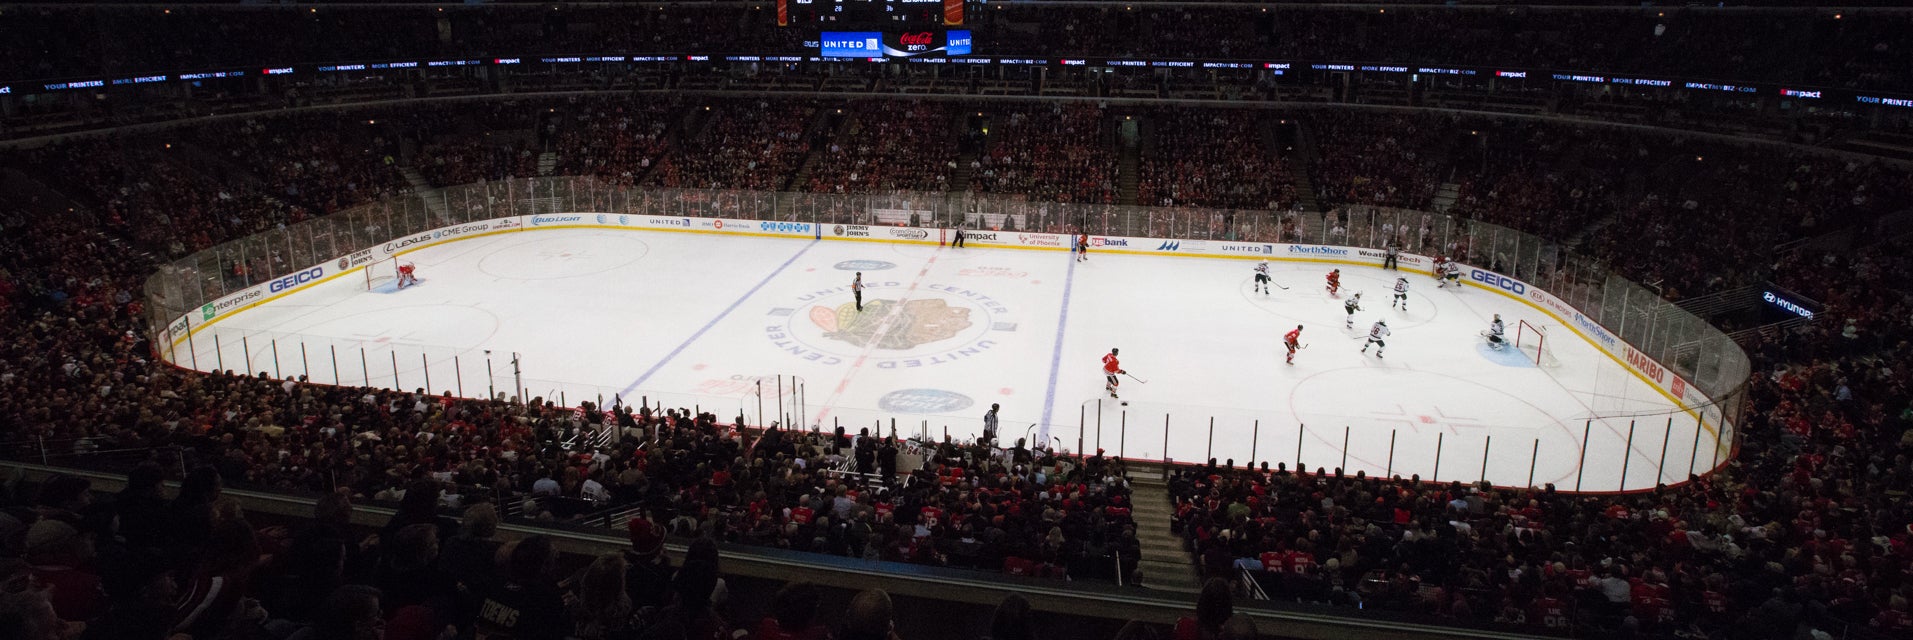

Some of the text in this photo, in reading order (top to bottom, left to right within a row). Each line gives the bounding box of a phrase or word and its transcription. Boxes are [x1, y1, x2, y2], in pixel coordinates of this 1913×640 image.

[823, 40, 864, 48] UNITED
[1500, 70, 1526, 78] impact
[1572, 75, 1604, 83] PRINTERS
[1634, 79, 1672, 87] EFFICIENT
[44, 83, 68, 92] YOUR
[68, 80, 104, 89] PRINTERS
[134, 75, 167, 84] EFFICIENT
[1786, 89, 1822, 99] impact
[1856, 96, 1880, 104] YOUR
[442, 223, 489, 237] CME Group
[964, 231, 997, 242] impact
[394, 234, 432, 249] LEXUS
[350, 248, 372, 260] JIMMY
[1294, 244, 1348, 255] NorthShore
[351, 254, 373, 268] JOHN'S
[1358, 250, 1421, 264] WeathTech
[269, 268, 323, 293] GEICO
[1471, 268, 1526, 296] GEICO
[798, 281, 901, 303] UNIED
[929, 282, 1008, 315] CENTER
[1532, 291, 1542, 300] KIA
[1577, 314, 1616, 345] NorthShore
[766, 324, 842, 366] CENTER
[876, 338, 998, 370] UNITED
[1626, 346, 1664, 384] HARIBO
[481, 598, 520, 628] TOEWS
